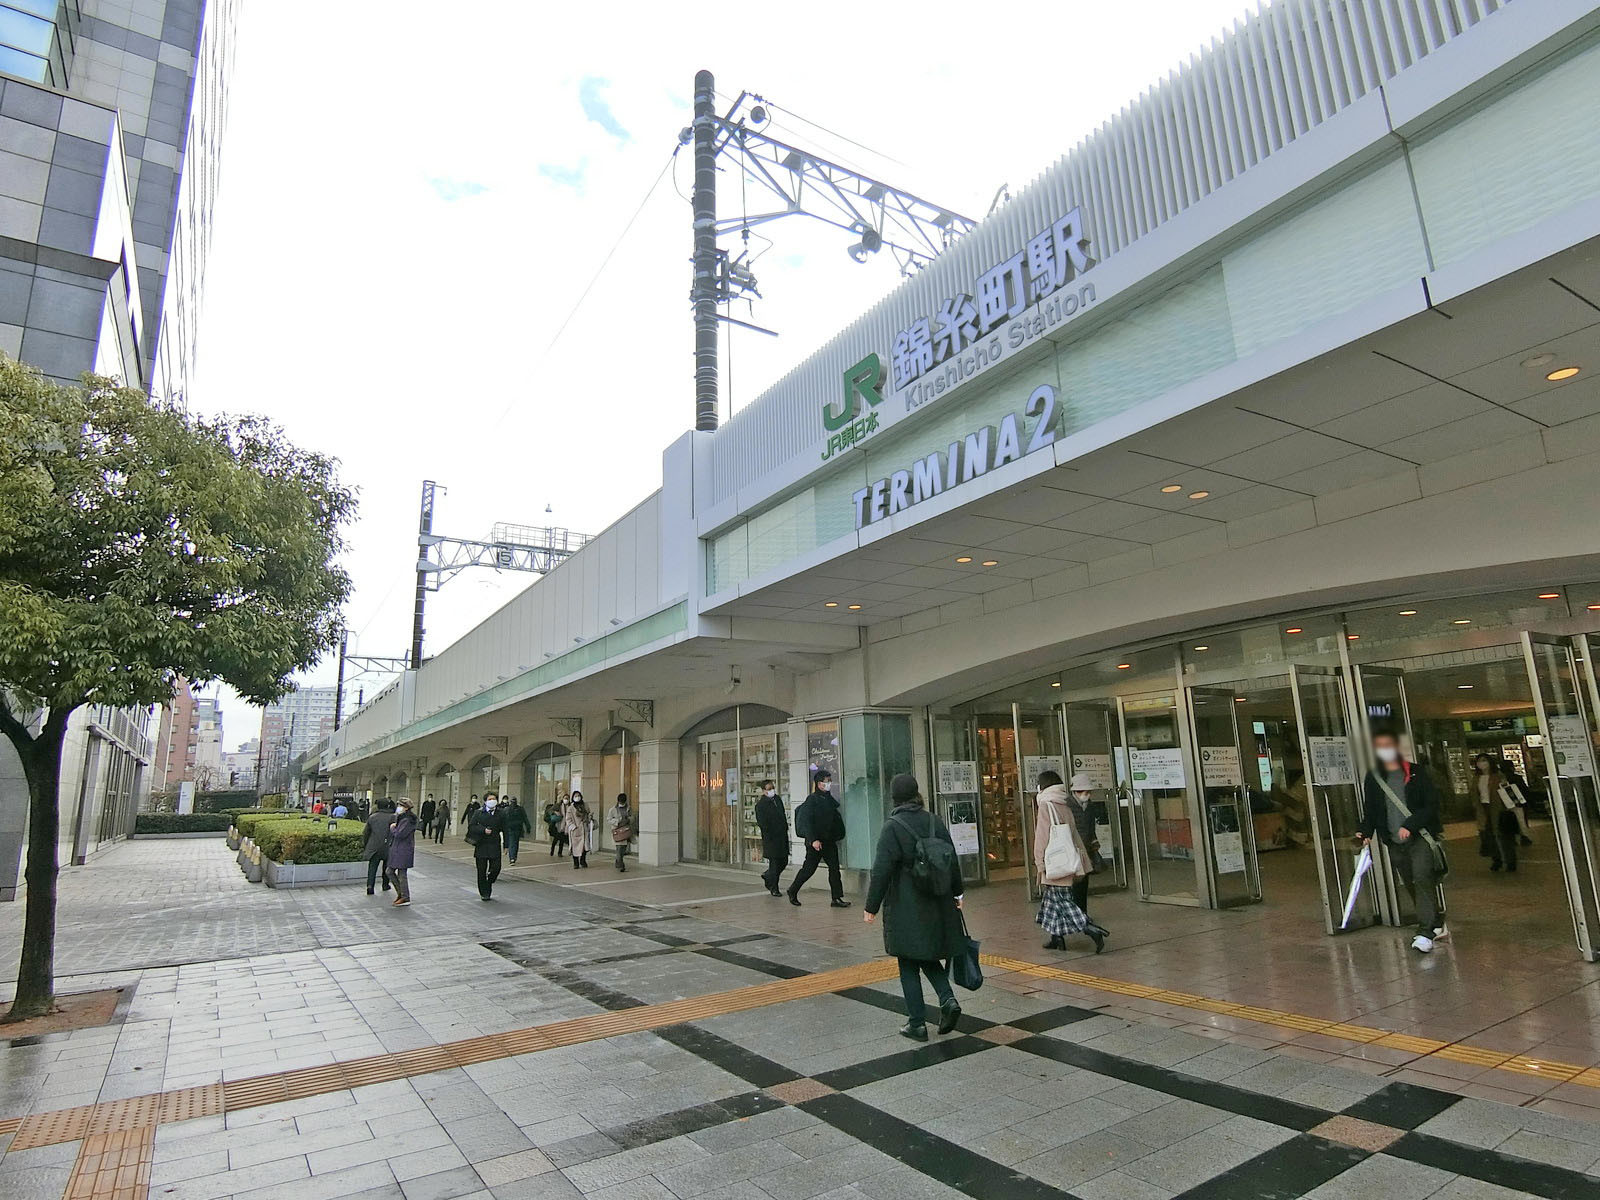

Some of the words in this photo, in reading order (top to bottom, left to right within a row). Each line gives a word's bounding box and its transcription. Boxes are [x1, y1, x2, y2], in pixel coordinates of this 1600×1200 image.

[892, 205, 1096, 391] 錦糸町駅
[903, 337, 1002, 412] Kinshichō
[1008, 281, 1097, 349] Station
[821, 411, 880, 461] JR東日本
[823, 352, 887, 431] JR
